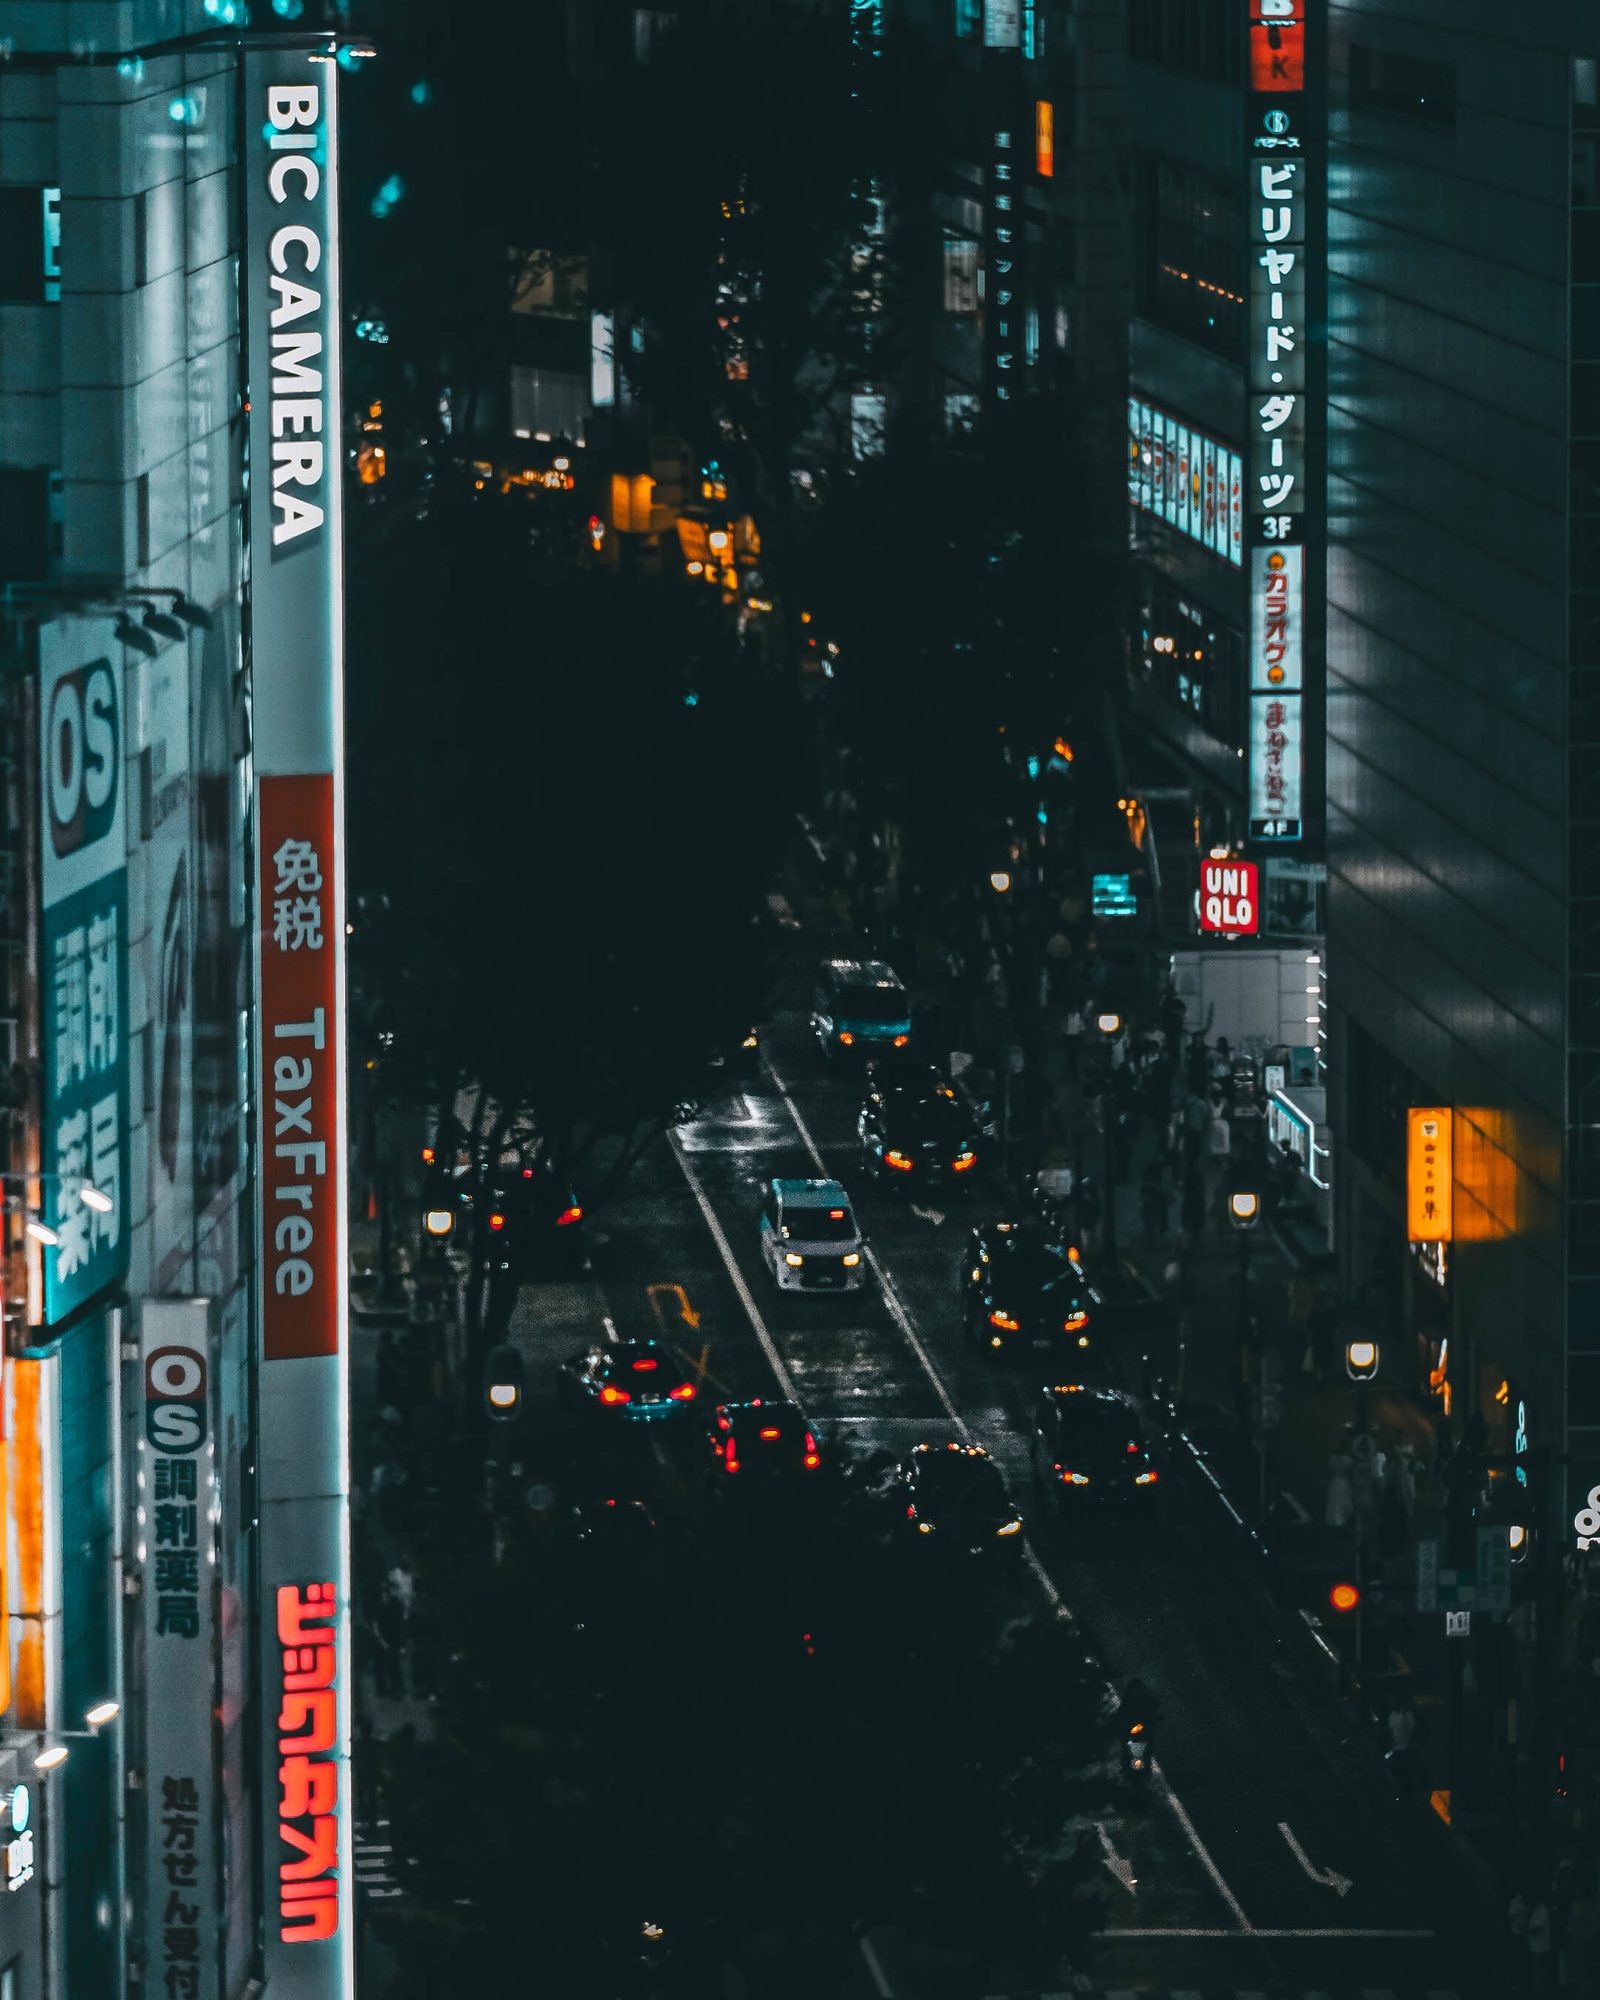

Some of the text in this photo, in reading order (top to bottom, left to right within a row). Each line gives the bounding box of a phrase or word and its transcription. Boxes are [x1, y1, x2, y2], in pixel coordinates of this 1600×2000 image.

[268, 85, 325, 546] BIC CAMERA
[1263, 516, 1291, 540] 3F
[273, 838, 324, 952] 免税
[1205, 866, 1248, 897] UNI
[1205, 896, 1253, 928] QLO
[273, 1008, 326, 1297] TaxFree
[151, 1354, 201, 1446] OS
[154, 1458, 199, 1639] 調剤薬局
[277, 1582, 337, 1943] ビックカメラ
